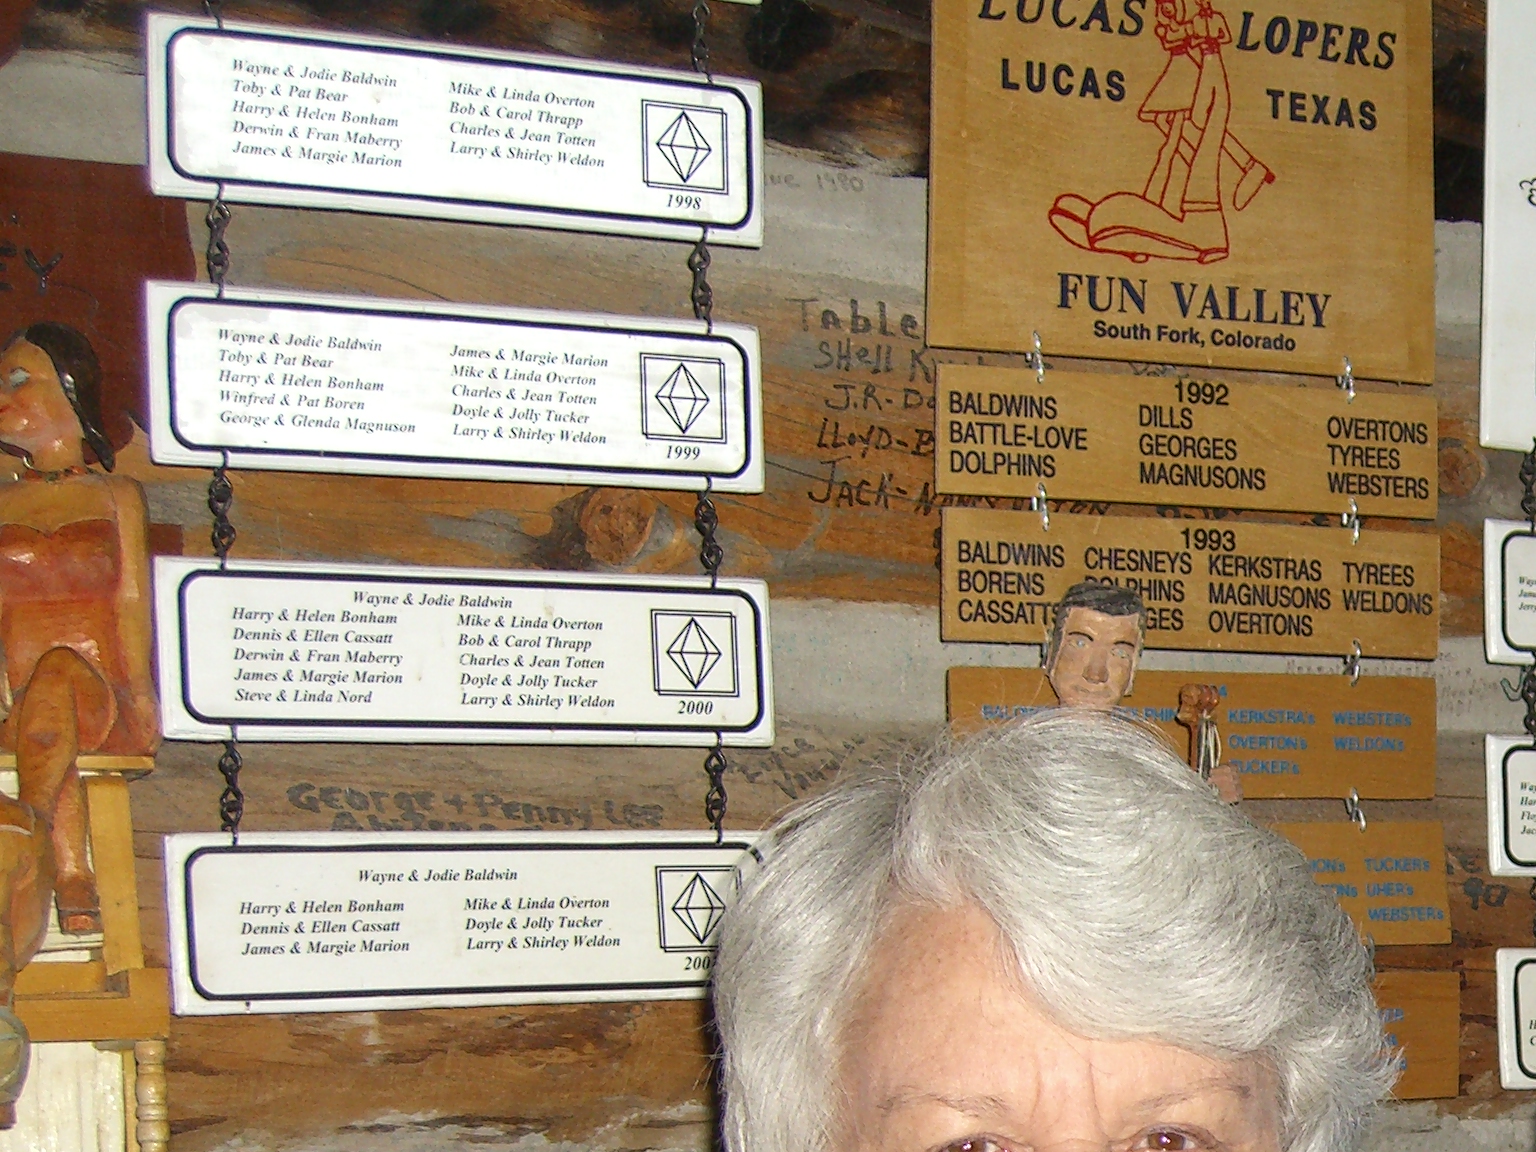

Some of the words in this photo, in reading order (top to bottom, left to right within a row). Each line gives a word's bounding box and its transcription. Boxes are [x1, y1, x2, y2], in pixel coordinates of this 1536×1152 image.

[1236, 11, 1397, 70] LOPERS
[233, 59, 279, 75] Wayne
[283, 65, 294, 77] &
[300, 66, 337, 80] Jodie
[342, 71, 396, 87] Baldwin
[1002, 58, 1126, 101] LUCAS
[1266, 88, 1377, 131] TEXAS
[451, 141, 487, 159] Larry
[491, 146, 501, 157] &
[507, 147, 552, 165] Shirley
[558, 152, 604, 167] Weldon
[668, 194, 701, 209] 1998
[1057, 272, 1147, 315] FUN
[1170, 281, 1332, 328] VALLEY
[1094, 319, 1150, 341] South
[1157, 325, 1205, 348] Fork,
[1211, 329, 1296, 351] Colorado
[221, 390, 275, 407] Winfred
[280, 394, 289, 406] &
[298, 395, 320, 407] Pat
[325, 396, 364, 409] Boren
[949, 390, 1058, 420] BALDWINS
[1175, 380, 1230, 406] 1992
[220, 411, 269, 427] George
[274, 414, 284, 426] &
[292, 415, 340, 428] Glenda
[345, 417, 415, 433] Magnuson
[1139, 404, 1193, 430] DILLS
[949, 420, 1088, 451] BATTLE-LOVE
[1327, 416, 1428, 445] OVERTONS
[667, 446, 700, 460] 1999
[1139, 434, 1237, 461] GEORGES
[1327, 444, 1401, 470] TYREES
[950, 450, 1056, 478] DOLPHINS
[1140, 462, 1266, 490] MAGNUSONS
[1327, 472, 1429, 499] WEBSTERS
[1180, 528, 1236, 551] 1993
[958, 540, 1065, 568] BALDWINS
[1084, 547, 1192, 575] CHESNEYS
[1209, 554, 1322, 581] KERKSTRAS
[1343, 561, 1414, 587] TYREES
[958, 570, 1045, 596] BORENS
[354, 591, 398, 604] Wayne
[403, 593, 413, 605] &
[419, 593, 455, 606] Jodie
[459, 595, 512, 608] Baldwin
[1209, 583, 1331, 610] MAGNUSONS
[1343, 589, 1433, 616] WELDONS
[232, 607, 274, 623] Harry
[278, 609, 288, 621] &
[295, 609, 335, 622] Helen
[341, 611, 397, 623] Bonham
[1209, 610, 1313, 637] OVERTONS
[458, 634, 484, 646] Bob
[488, 635, 499, 647] &
[505, 635, 541, 648] Carol
[546, 636, 591, 652] Thrapp
[459, 653, 509, 666] Charles
[514, 655, 524, 667] &
[529, 655, 560, 667] Jean
[566, 656, 604, 668] Totten
[235, 689, 272, 701] Steve
[276, 689, 286, 701] &
[294, 690, 333, 702] Linda
[337, 690, 372, 703] Nord
[678, 700, 713, 714] 2000
[464, 898, 497, 910] Mike
[501, 898, 511, 910] &
[518, 897, 554, 909] Linda
[559, 897, 609, 909] Overton
[241, 922, 289, 935] Dennis
[294, 921, 305, 933] &
[311, 921, 346, 933] Ellen
[352, 920, 400, 932] Cassatt
[465, 918, 503, 933] Doyle
[507, 917, 517, 929] &
[522, 917, 554, 931] Jolly
[559, 916, 603, 928] Tucker
[241, 943, 285, 955] James
[289, 942, 300, 954] &
[307, 941, 356, 956] Margie
[360, 940, 409, 952] Marion
